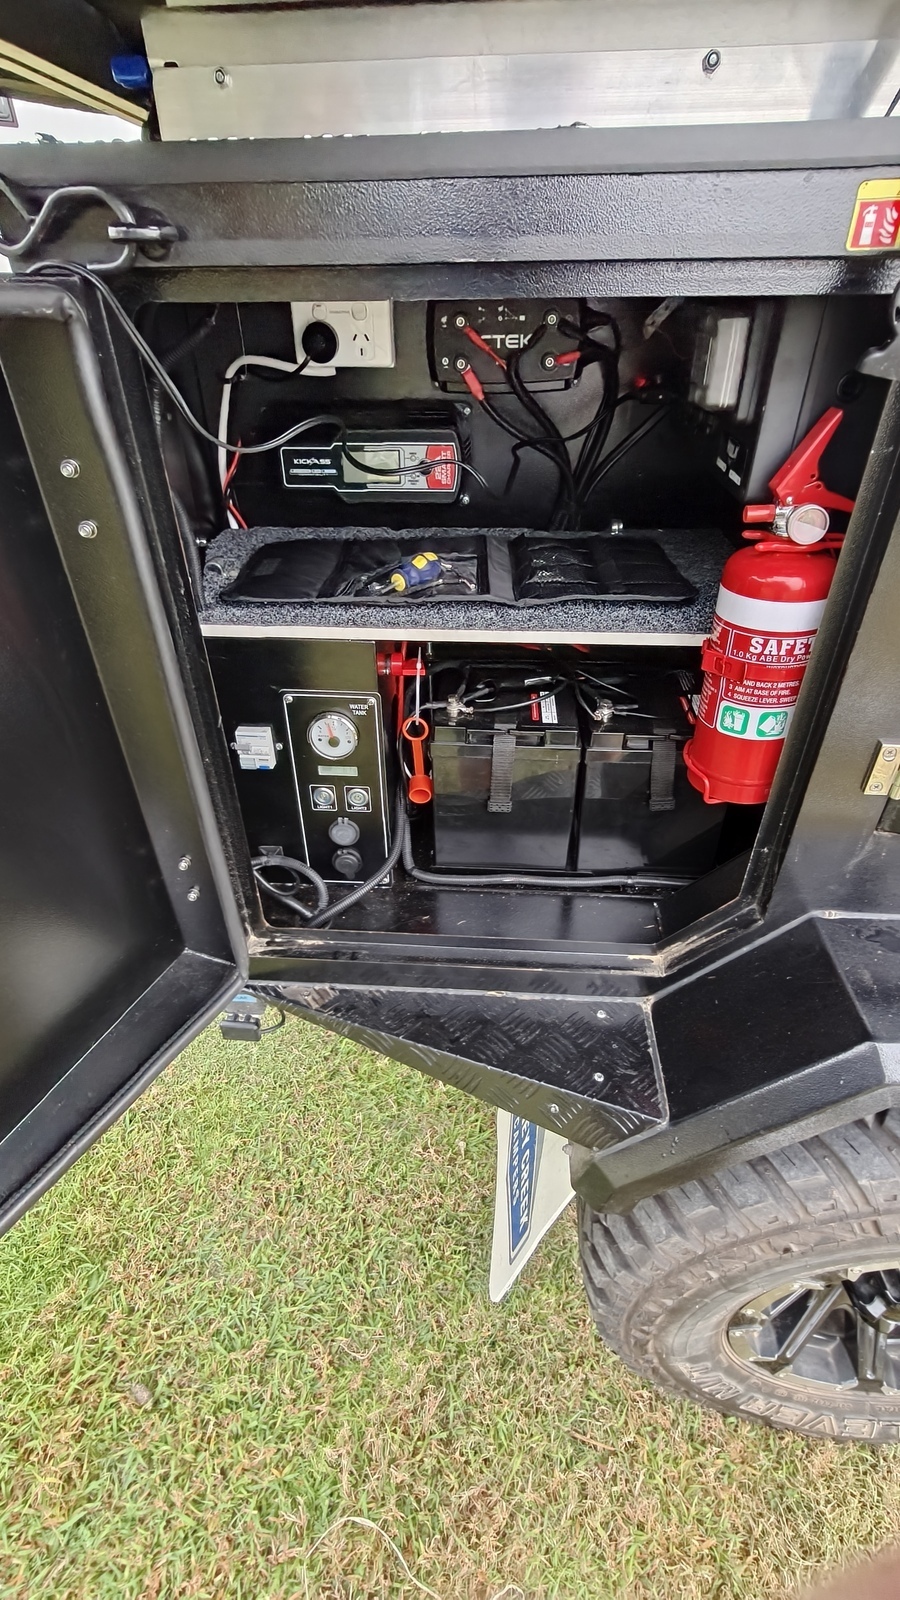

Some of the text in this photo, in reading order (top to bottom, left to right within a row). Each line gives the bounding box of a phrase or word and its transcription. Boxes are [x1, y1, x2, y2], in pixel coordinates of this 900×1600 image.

[293, 457, 332, 466] KICKASS
[732, 649, 744, 658] 1.0
[745, 652, 757, 662] Kg
[759, 655, 778, 663] ABE
[780, 655, 796, 664] Dry
[734, 685, 745, 693] AIM
[753, 688, 769, 696] BASE
[756, 681, 774, 689] BACK
[733, 693, 759, 703] SQUEEZE
[512, 1117, 520, 1206] CAMPERS
[519, 1118, 530, 1233] EY CREEK
